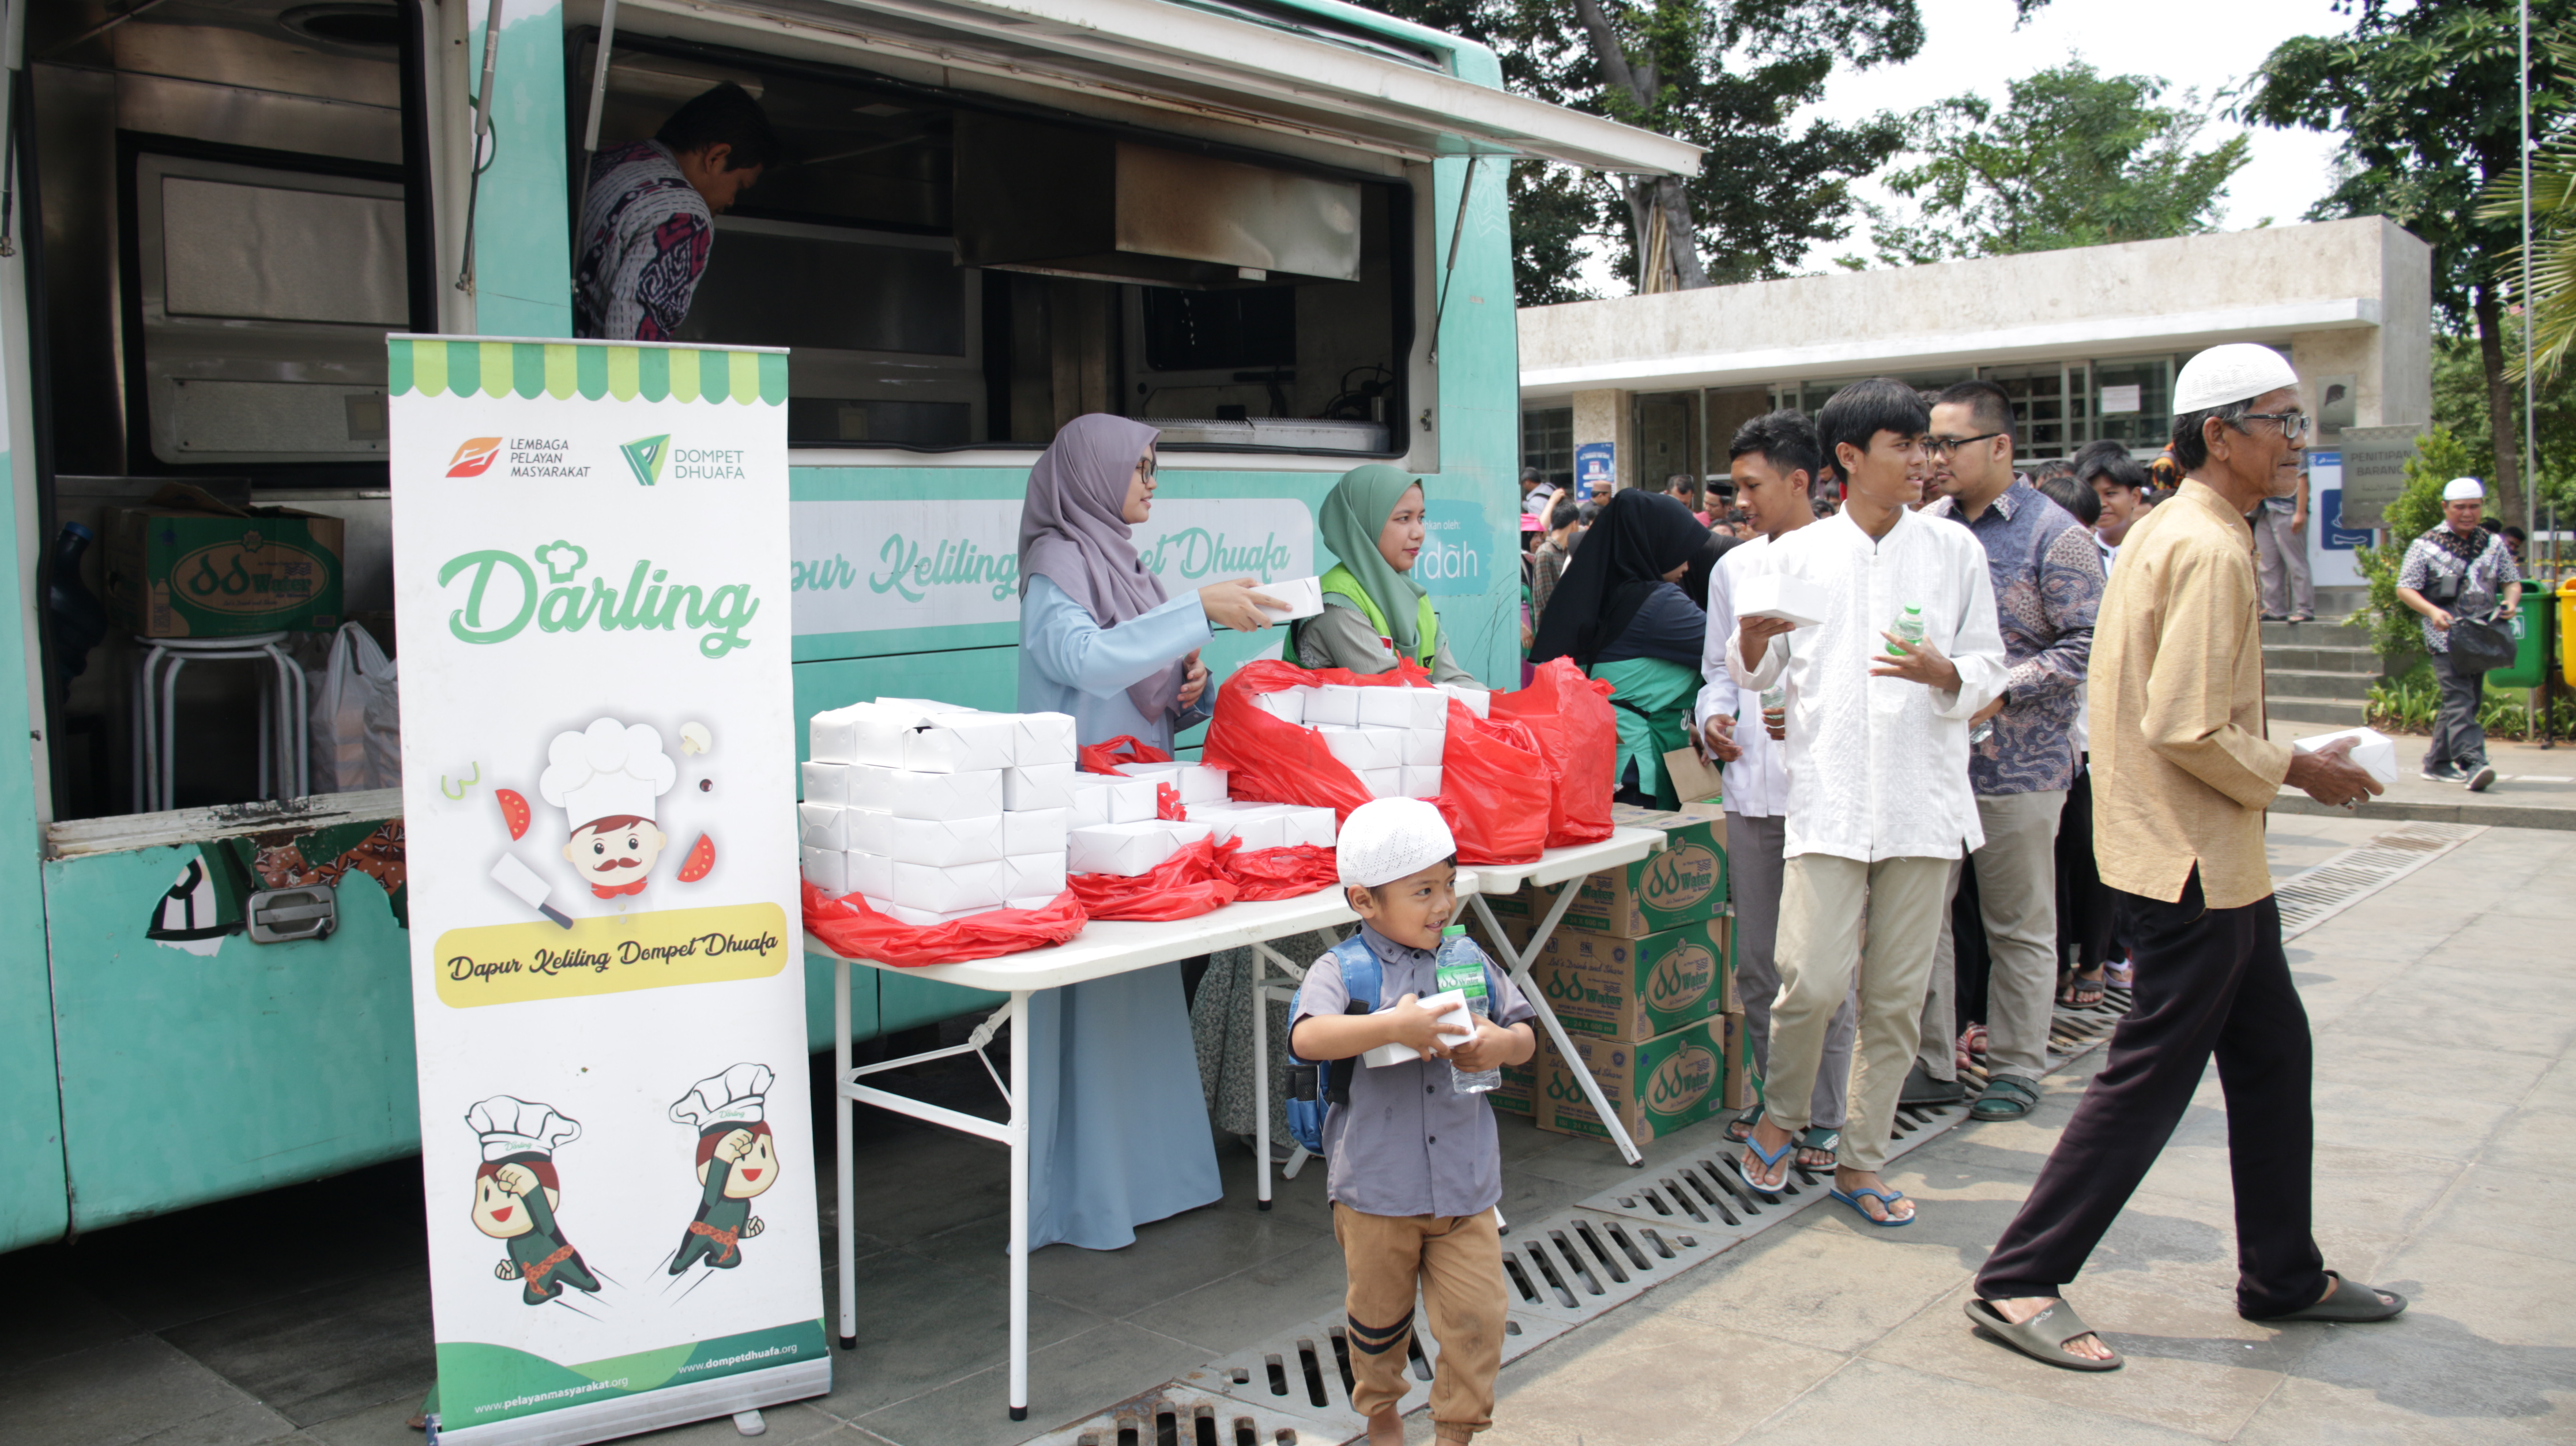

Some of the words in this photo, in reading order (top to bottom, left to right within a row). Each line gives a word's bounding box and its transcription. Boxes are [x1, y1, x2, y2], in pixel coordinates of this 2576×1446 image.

[511, 439, 569, 450] LEMBAGA
[511, 452, 563, 464] PELAYAN
[675, 450, 744, 463] DOMPET
[2351, 450, 2411, 462] PENITIPAN
[511, 466, 590, 478] MASYARAKAT
[675, 466, 745, 479] DHUAFA
[1443, 519, 1461, 529] oleh:
[869, 533, 1020, 603] Keliling
[1175, 527, 1291, 585] Dhuafa
[251, 573, 312, 594] Water
[437, 549, 760, 659] Darling
[1680, 872, 1712, 891] Water
[1581, 884, 1615, 900] Water
[1580, 943, 1592, 952] SNI
[447, 955, 522, 982] Dapur
[529, 948, 611, 976] Keliling
[617, 938, 700, 964] Dompet
[698, 931, 779, 956] Dhuafa
[1682, 972, 1708, 990] Water
[1586, 988, 1623, 1005] Water
[1579, 1045, 1591, 1055] SNI
[1684, 1072, 1709, 1092] Water
[719, 1108, 745, 1119] Darling
[504, 1140, 532, 1151] Darling
[678, 1343, 797, 1374] www.dompetdhuafa.org
[475, 1376, 628, 1414] www.pelayanmasyarakat.org
